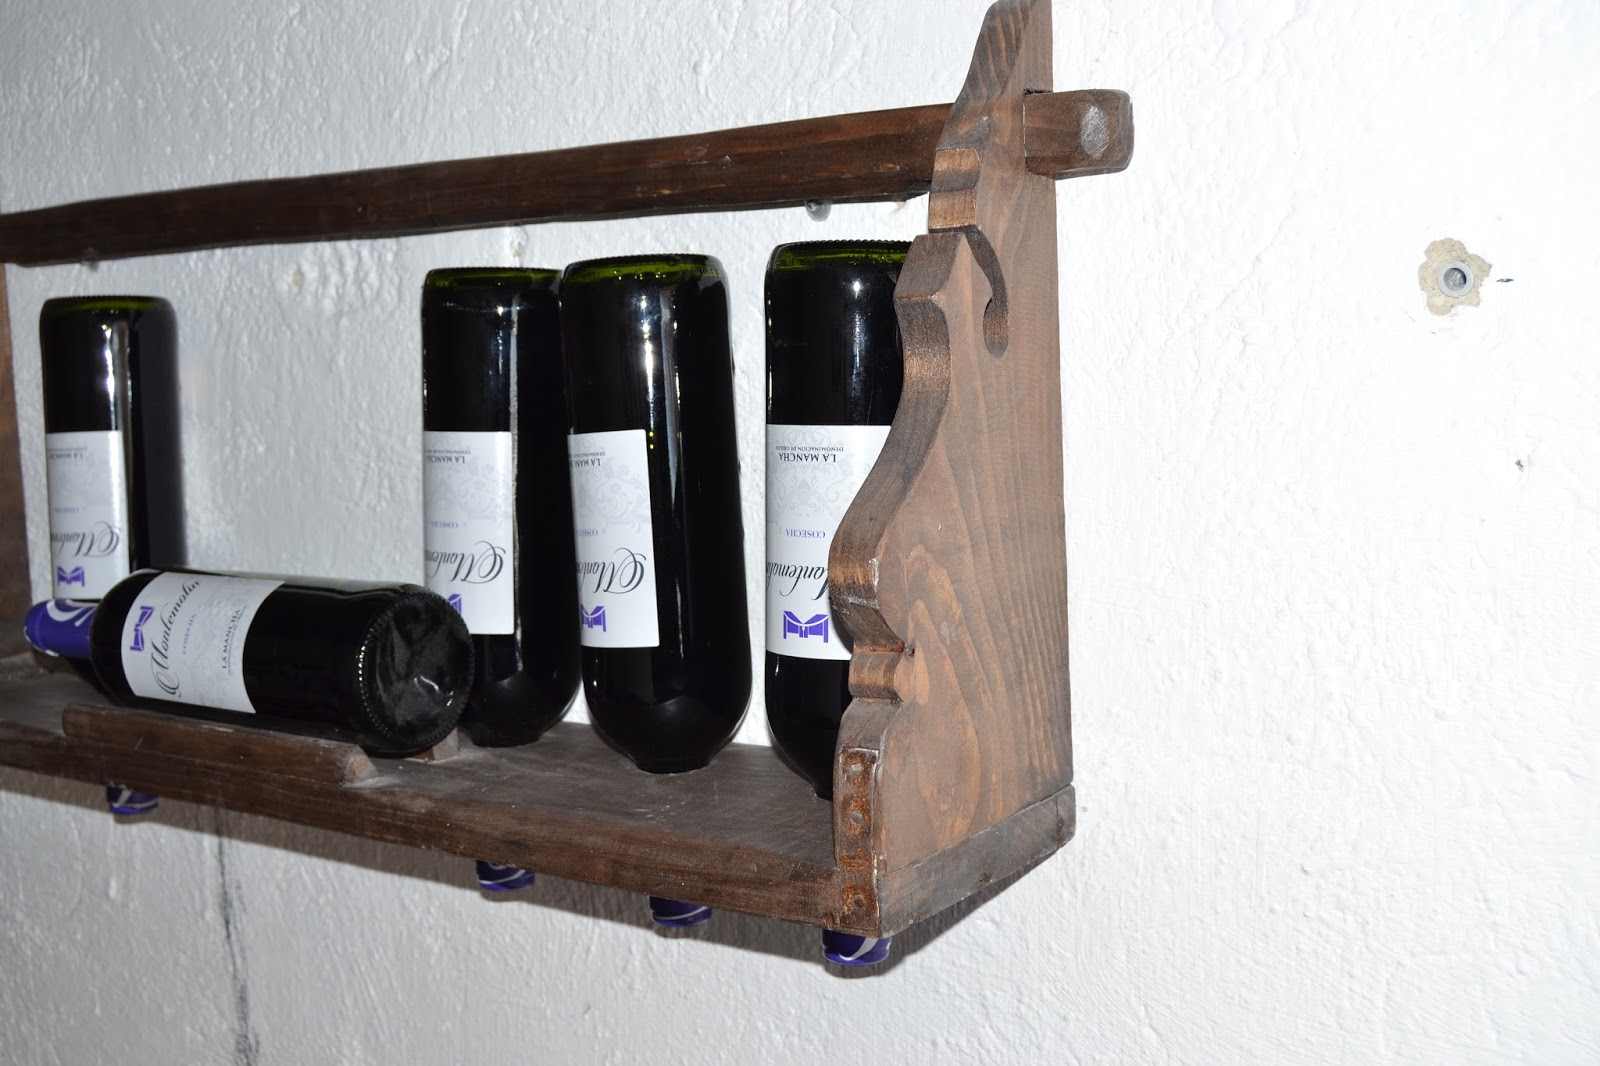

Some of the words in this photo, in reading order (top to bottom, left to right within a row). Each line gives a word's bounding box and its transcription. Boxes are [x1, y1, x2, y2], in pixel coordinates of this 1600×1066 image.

[778, 452, 820, 462] MANCHA
[822, 453, 837, 462] LA
[785, 528, 826, 539] COSECHA
[222, 609, 241, 654] MANCHA
